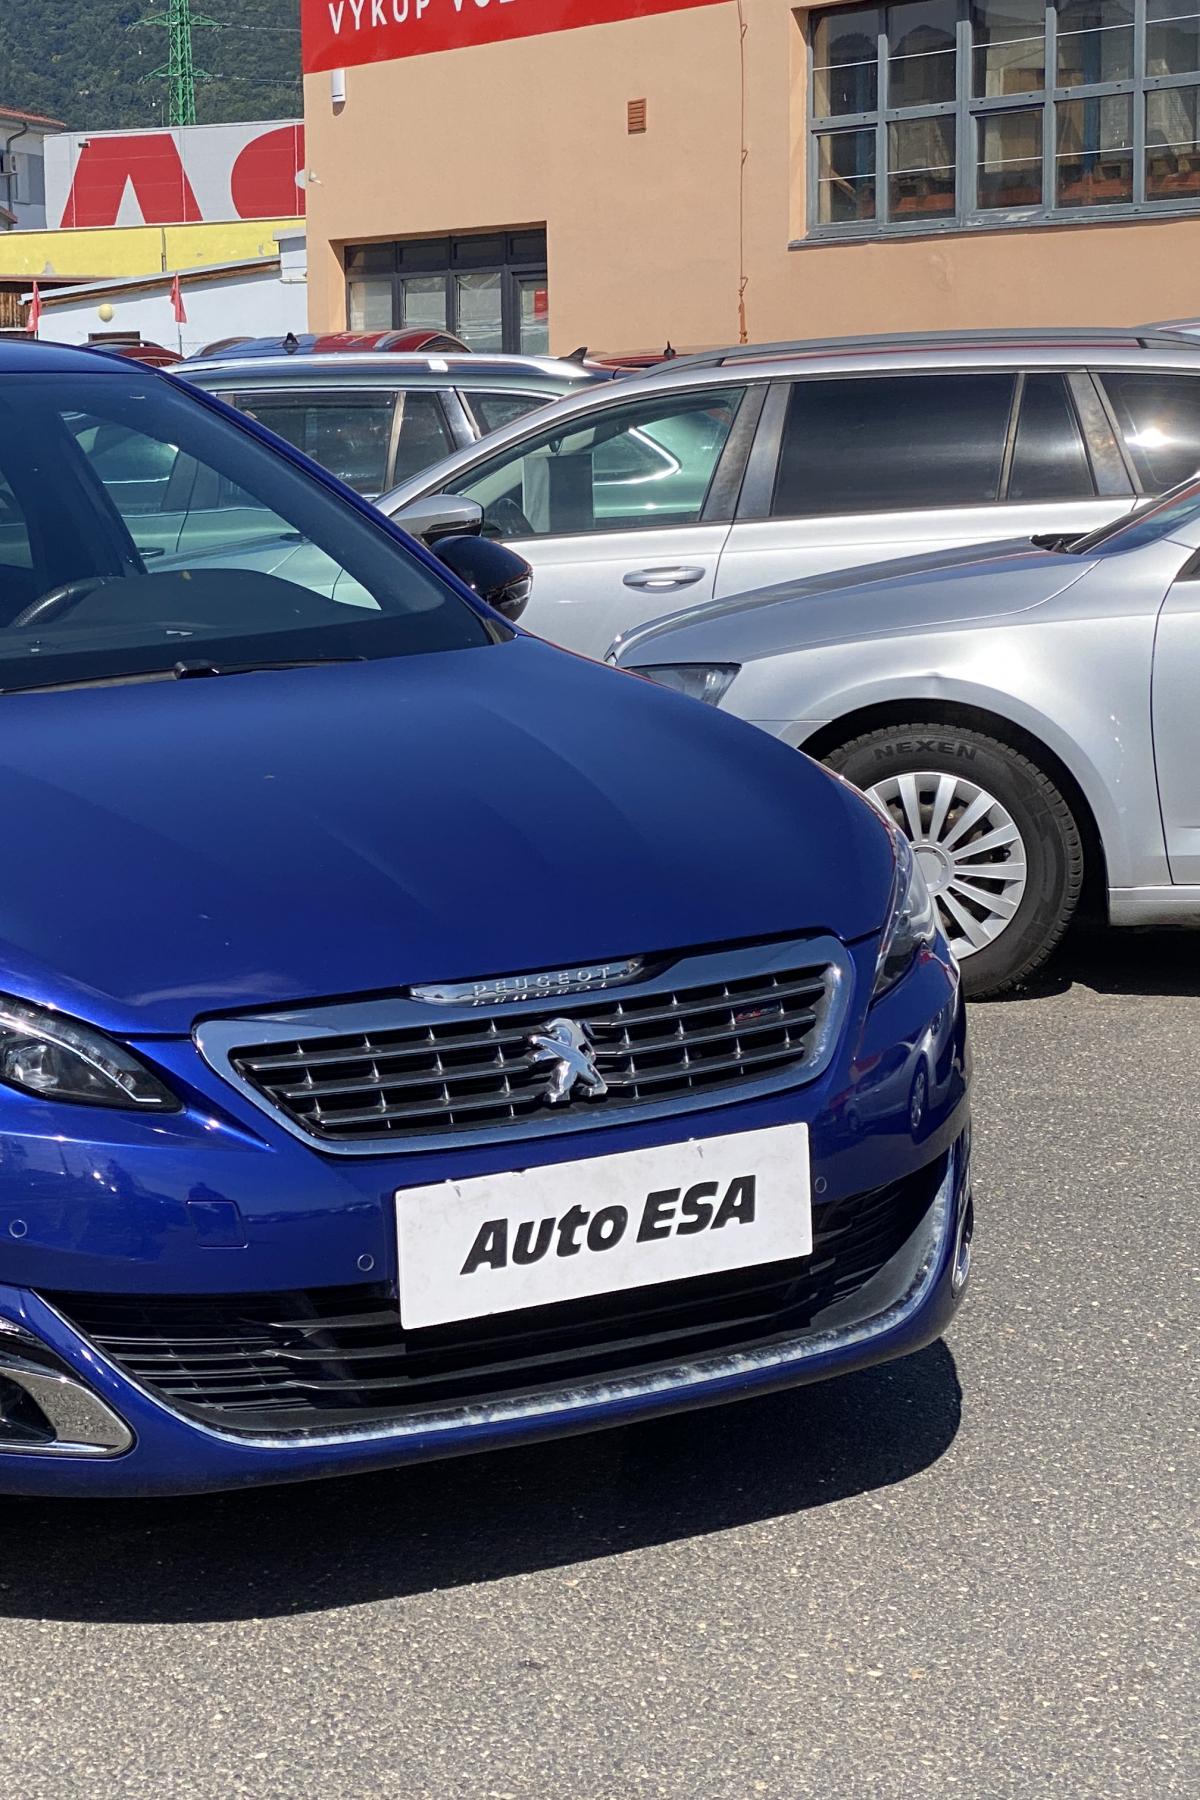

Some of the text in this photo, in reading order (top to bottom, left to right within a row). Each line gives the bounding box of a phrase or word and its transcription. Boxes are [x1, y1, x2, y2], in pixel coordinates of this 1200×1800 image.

[873, 740, 977, 760] NEXEN
[473, 966, 610, 996] PEUGEOT
[459, 1174, 756, 1275] Auto ESA
